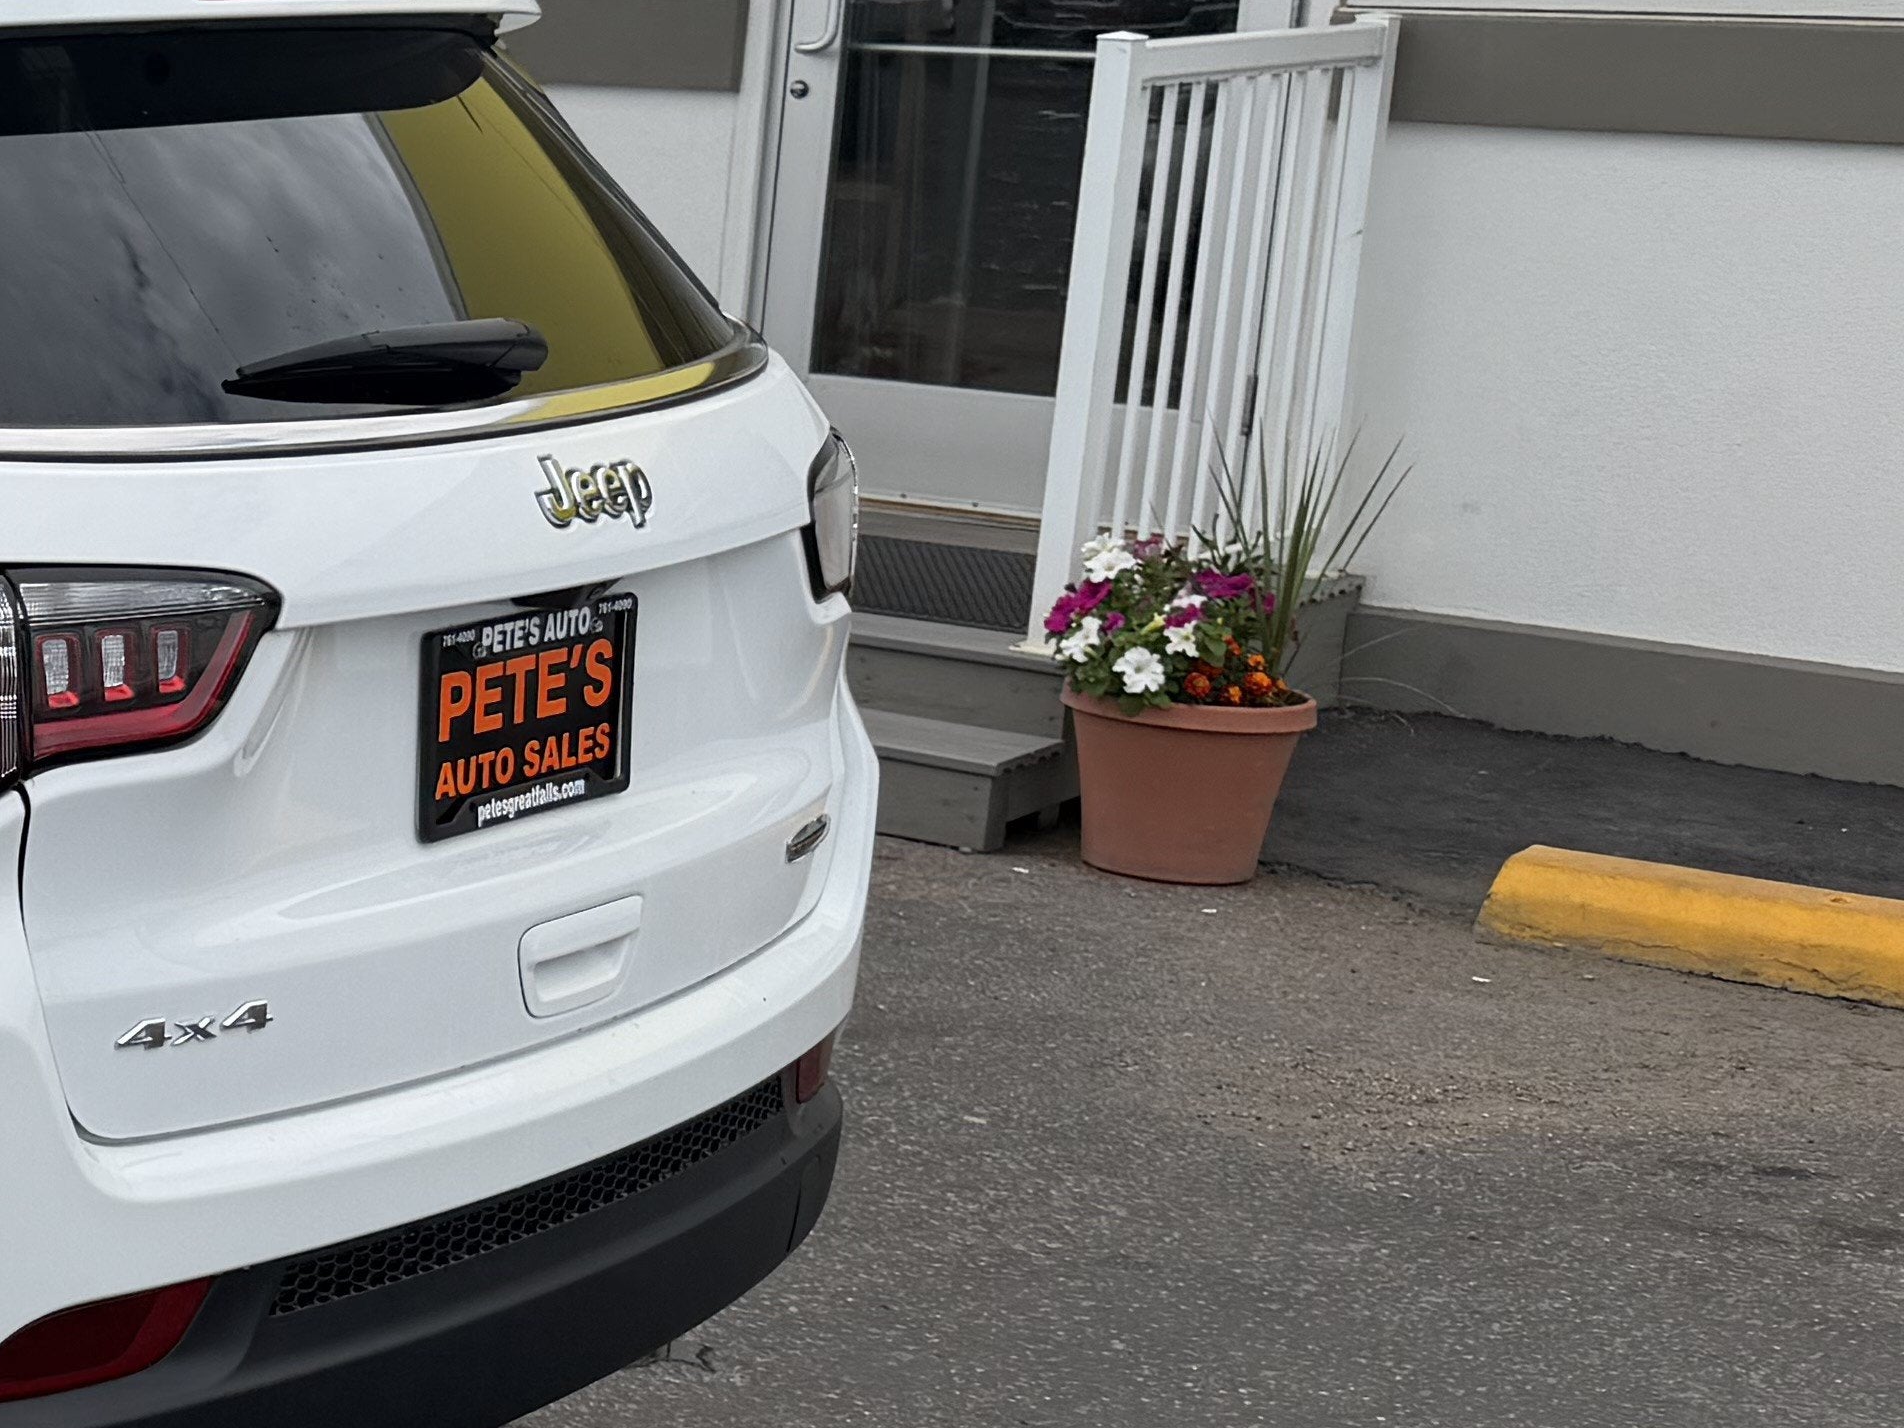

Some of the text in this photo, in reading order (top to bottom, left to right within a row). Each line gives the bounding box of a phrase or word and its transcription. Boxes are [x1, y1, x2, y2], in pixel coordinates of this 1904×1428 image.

[534, 454, 652, 529] Jeep
[482, 606, 591, 654] PETE'S AUTO
[437, 638, 614, 743] PETE'S
[435, 722, 611, 801] AUTO SALES
[478, 778, 586, 828] petesgreatfalls.com
[114, 999, 274, 1051] 4x4
